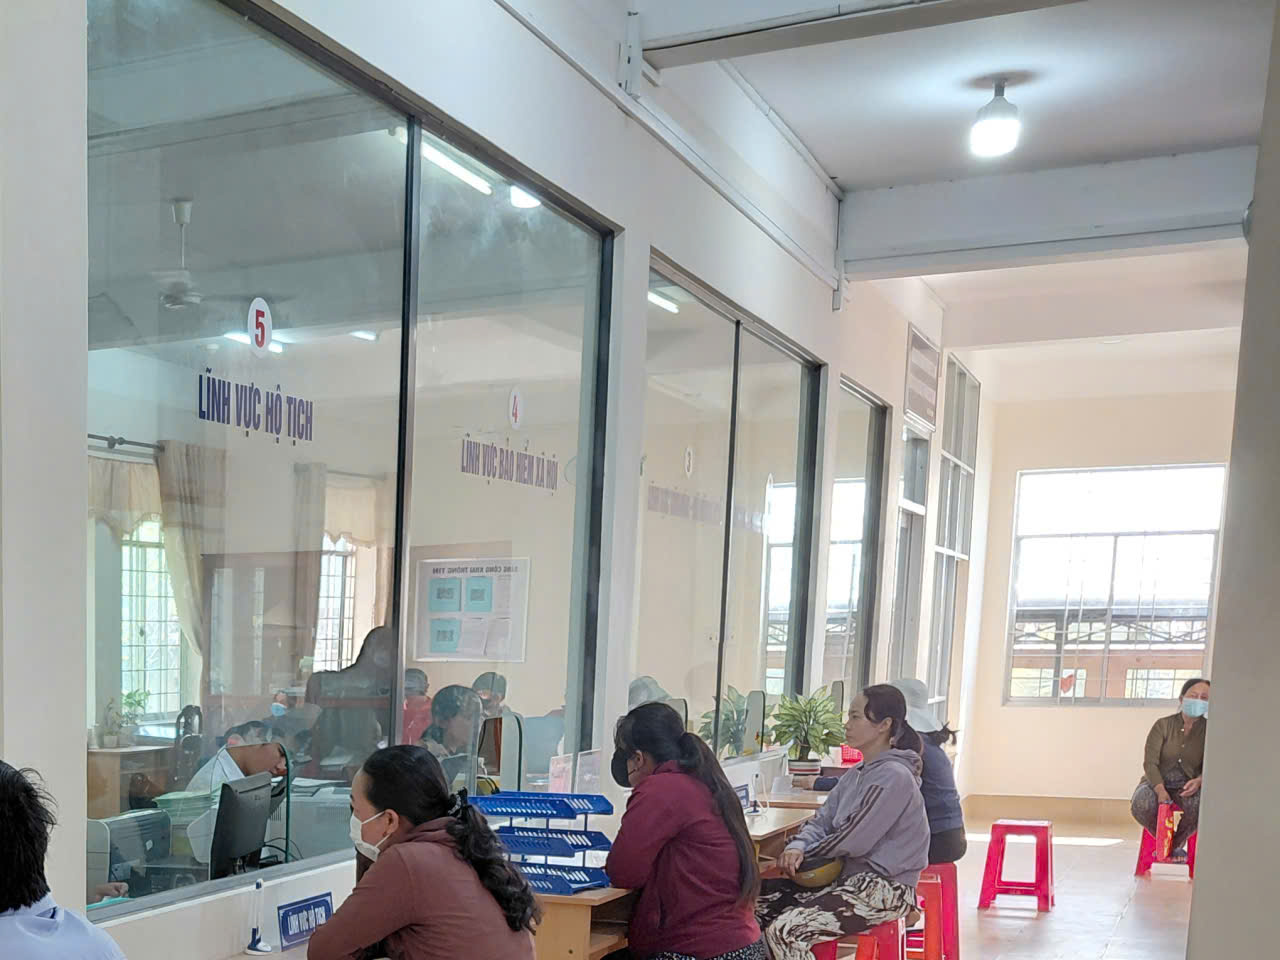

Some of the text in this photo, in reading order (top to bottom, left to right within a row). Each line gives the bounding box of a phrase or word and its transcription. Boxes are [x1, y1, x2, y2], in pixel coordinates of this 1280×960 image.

[254, 309, 266, 349] 5
[198, 367, 314, 447] LĨNH VỰC HỘ TỊCH
[511, 395, 520, 424] 4
